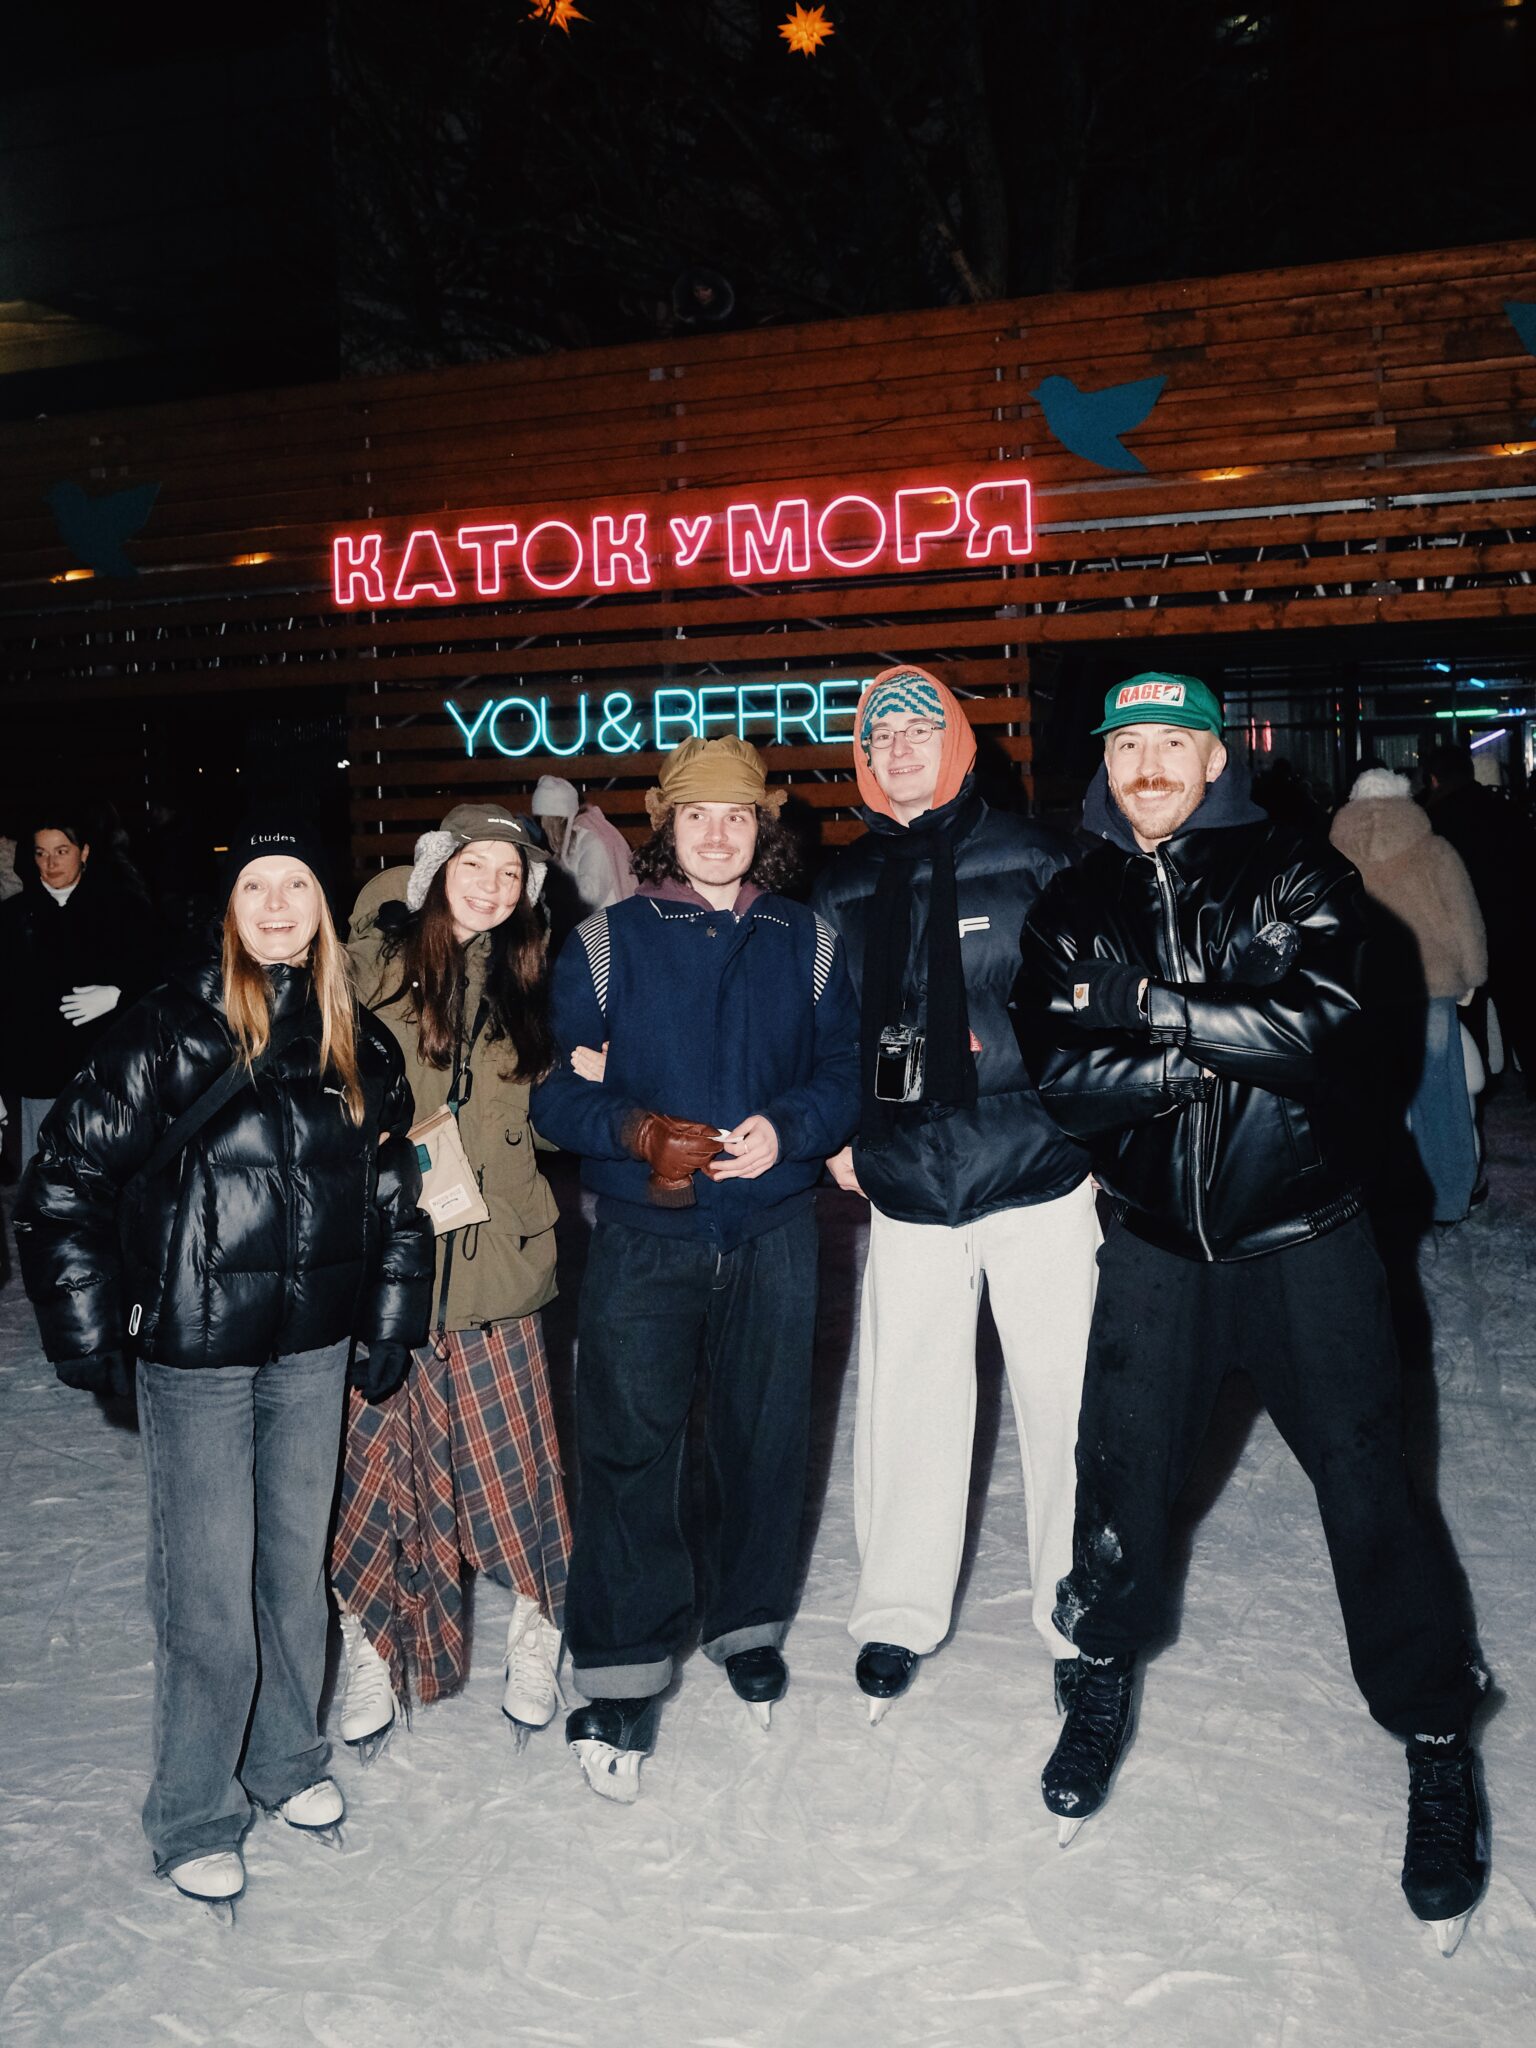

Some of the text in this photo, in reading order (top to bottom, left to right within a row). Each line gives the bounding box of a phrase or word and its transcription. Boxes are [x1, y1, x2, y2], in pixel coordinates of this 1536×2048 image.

[333, 512, 652, 605] КАТОК
[727, 479, 1031, 578] МОРЯ
[1119, 684, 1162, 705] RAGE
